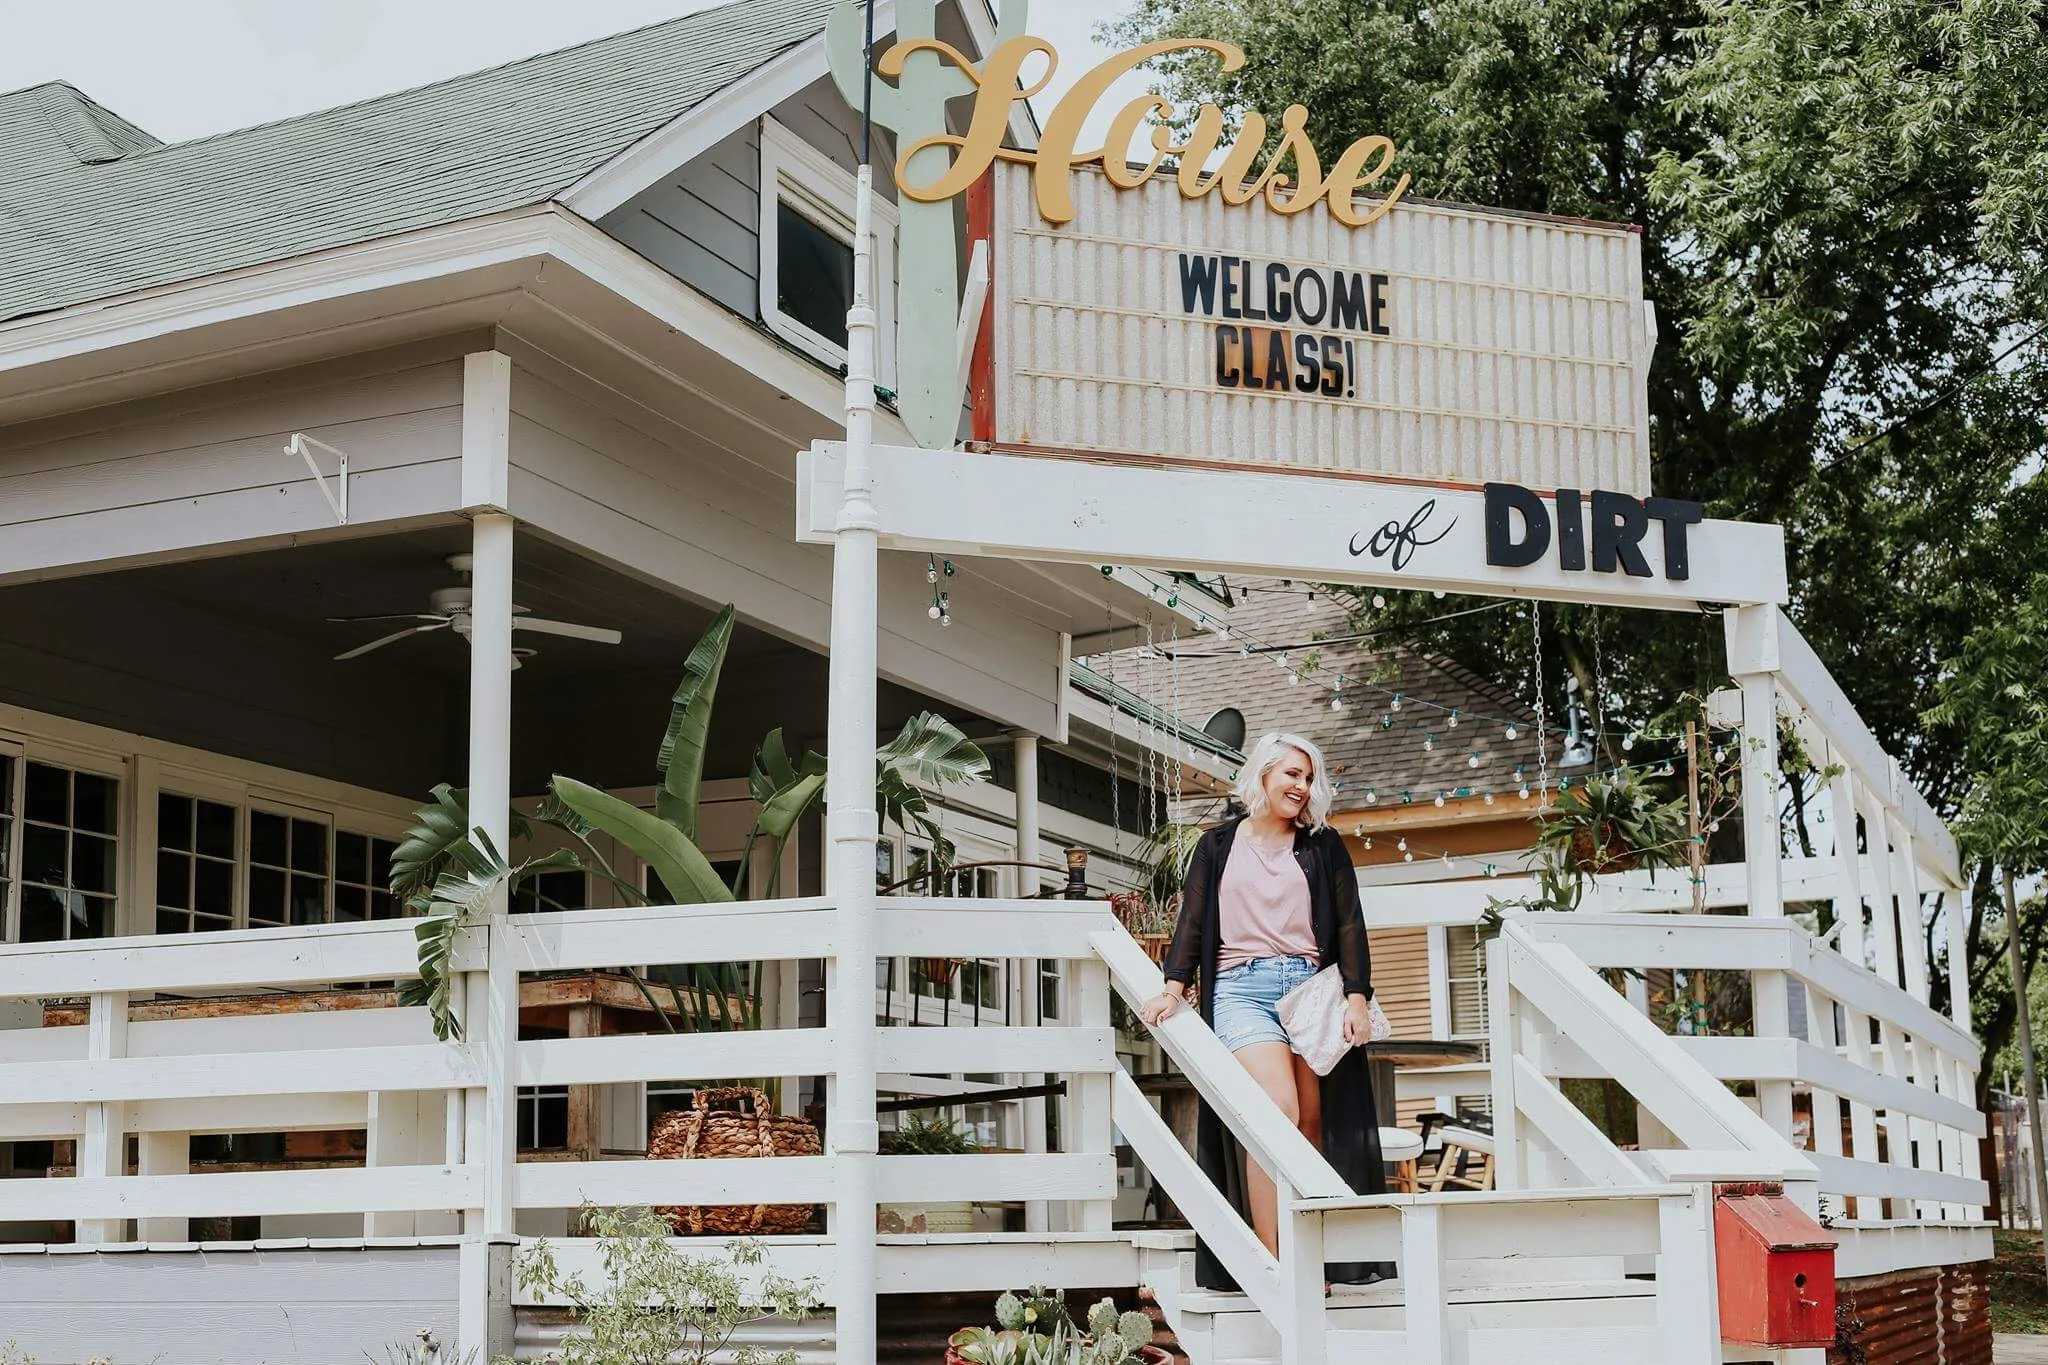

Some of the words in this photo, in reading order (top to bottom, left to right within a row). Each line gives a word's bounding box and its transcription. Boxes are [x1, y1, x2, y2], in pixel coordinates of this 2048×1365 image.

[879, 35, 1410, 228] House
[1216, 325, 1354, 398] CLASS!
[1349, 499, 1458, 571] of
[1484, 482, 1702, 580] DIRT
